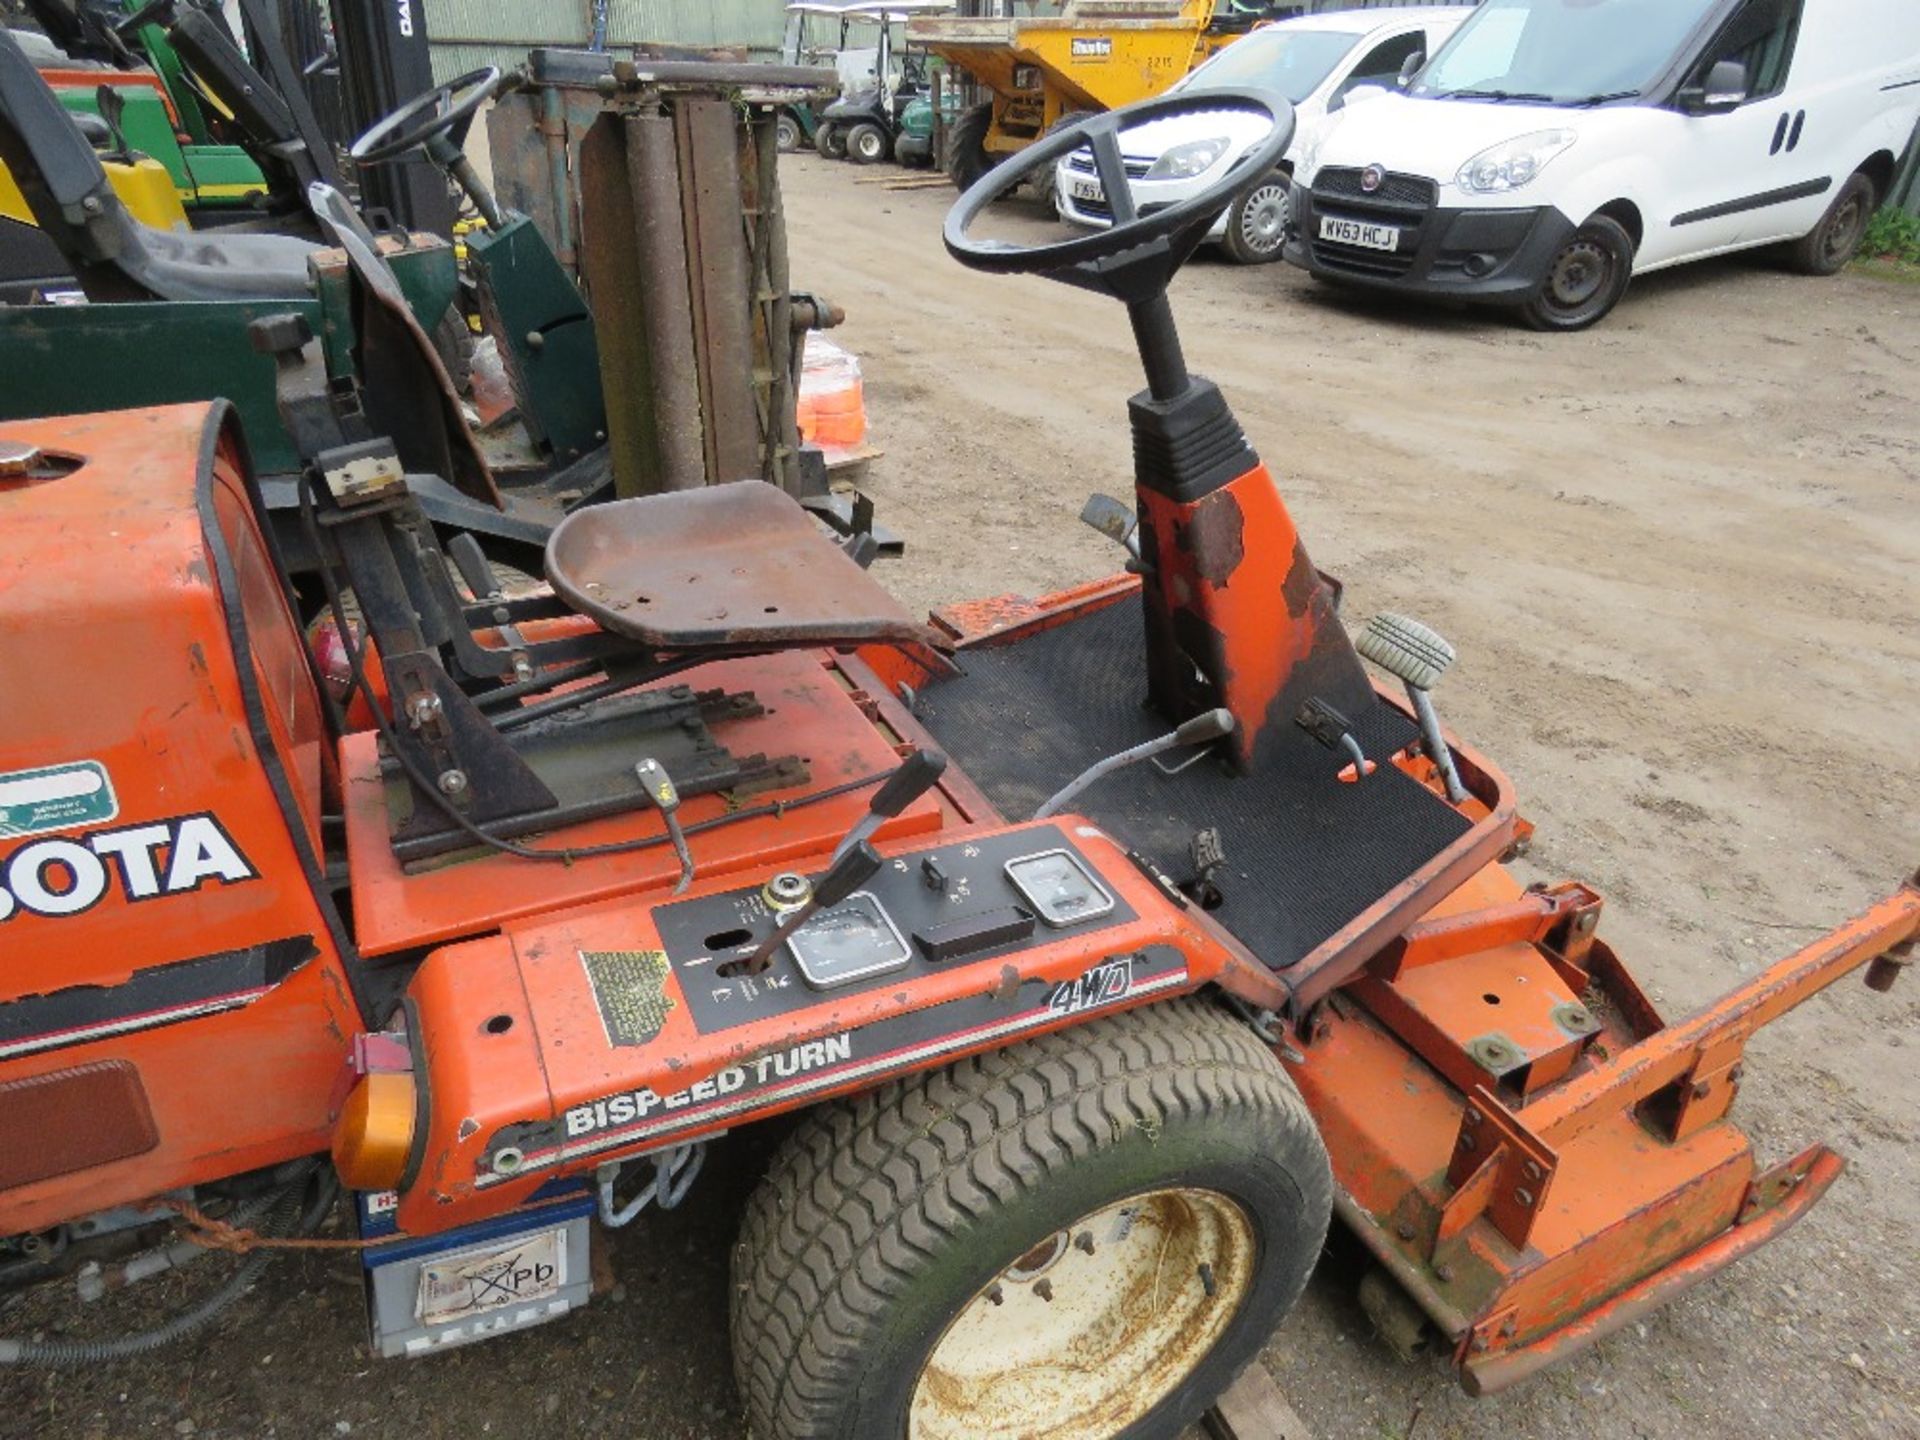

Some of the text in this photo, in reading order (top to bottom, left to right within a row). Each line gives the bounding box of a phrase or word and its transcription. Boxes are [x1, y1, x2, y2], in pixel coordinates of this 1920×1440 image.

[397, 0, 413, 37] DA
[1363, 226, 1393, 247] HCJ
[0, 811, 261, 921] OTA
[1048, 958, 1132, 1012] 4WD
[747, 1032, 852, 1083] TURN
[513, 1262, 554, 1289] Pb
